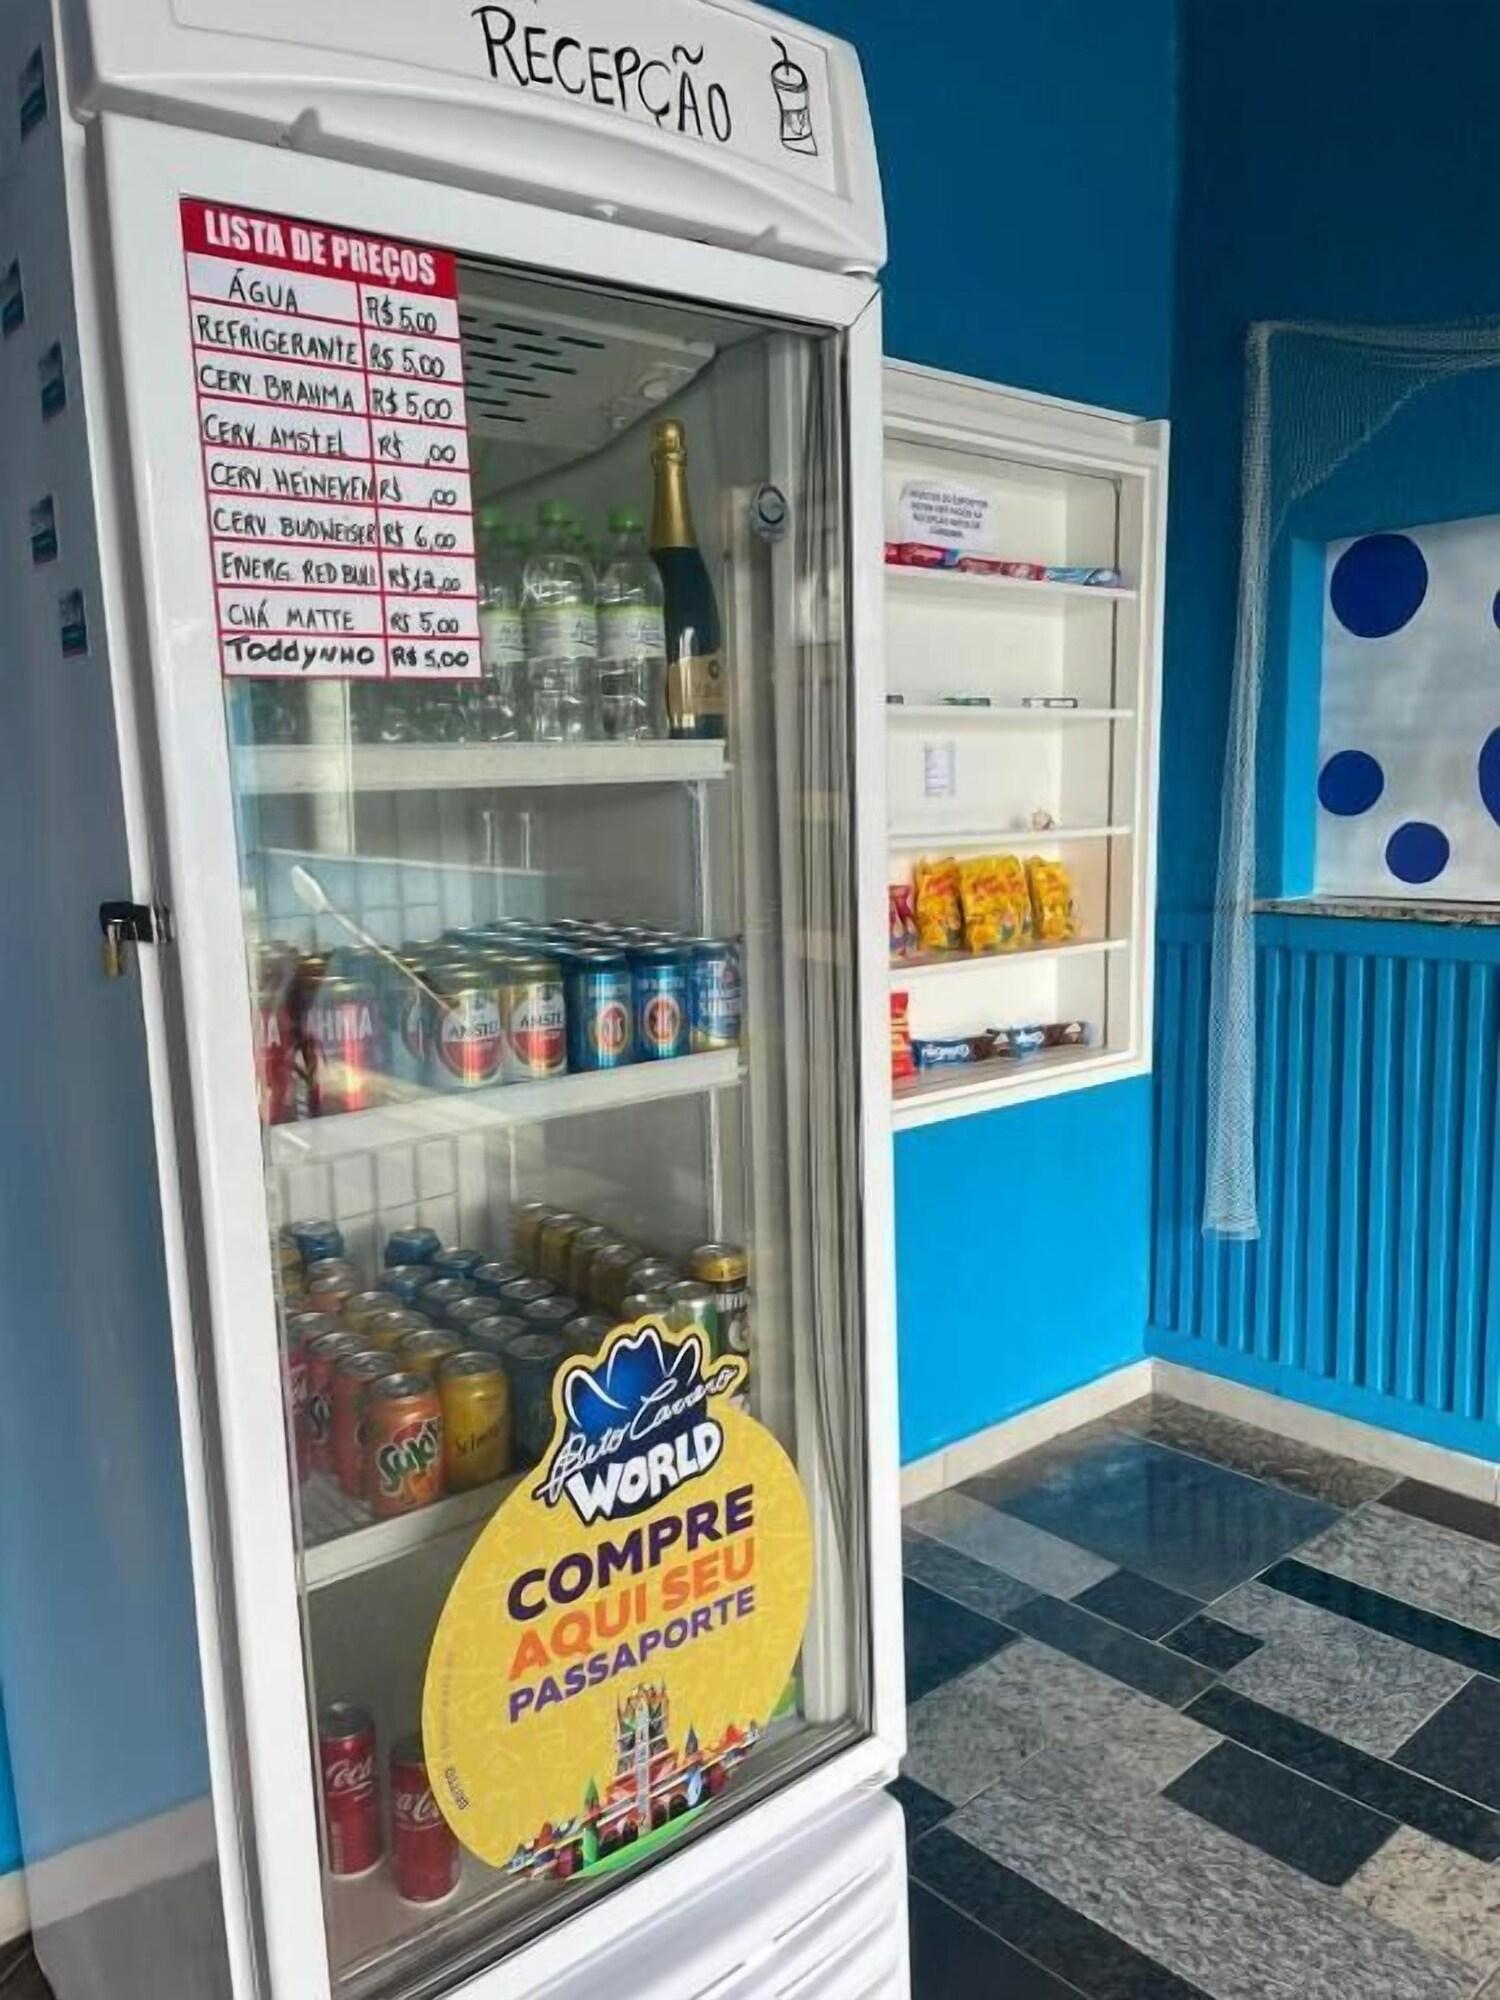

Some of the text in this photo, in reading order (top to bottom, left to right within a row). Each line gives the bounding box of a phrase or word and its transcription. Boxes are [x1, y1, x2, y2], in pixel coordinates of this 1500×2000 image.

[471, 5, 733, 143] RECEPÇÃO
[204, 209, 437, 286] LISTA DE PREÇOS
[228, 267, 299, 313] ÁGUA
[366, 295, 394, 327] R$
[401, 348, 446, 379] 5,00
[263, 374, 356, 414] BRAHMA
[372, 387, 398, 416] R$
[405, 393, 453, 424] 5,00
[270, 424, 347, 457] AMSTEL
[279, 516, 377, 546] BUDWEISER
[228, 598, 270, 629] CHÁ
[286, 607, 355, 631] MATTE
[418, 611, 460, 638] 5,00
[392, 645, 418, 667] R$
[424, 649, 470, 670] 5,00
[566, 1422, 722, 1522] WORLD
[507, 1484, 754, 1621] COMPRE
[509, 1536, 755, 1681] AQUI SEU
[509, 1585, 756, 1724] PASSAPORTE
